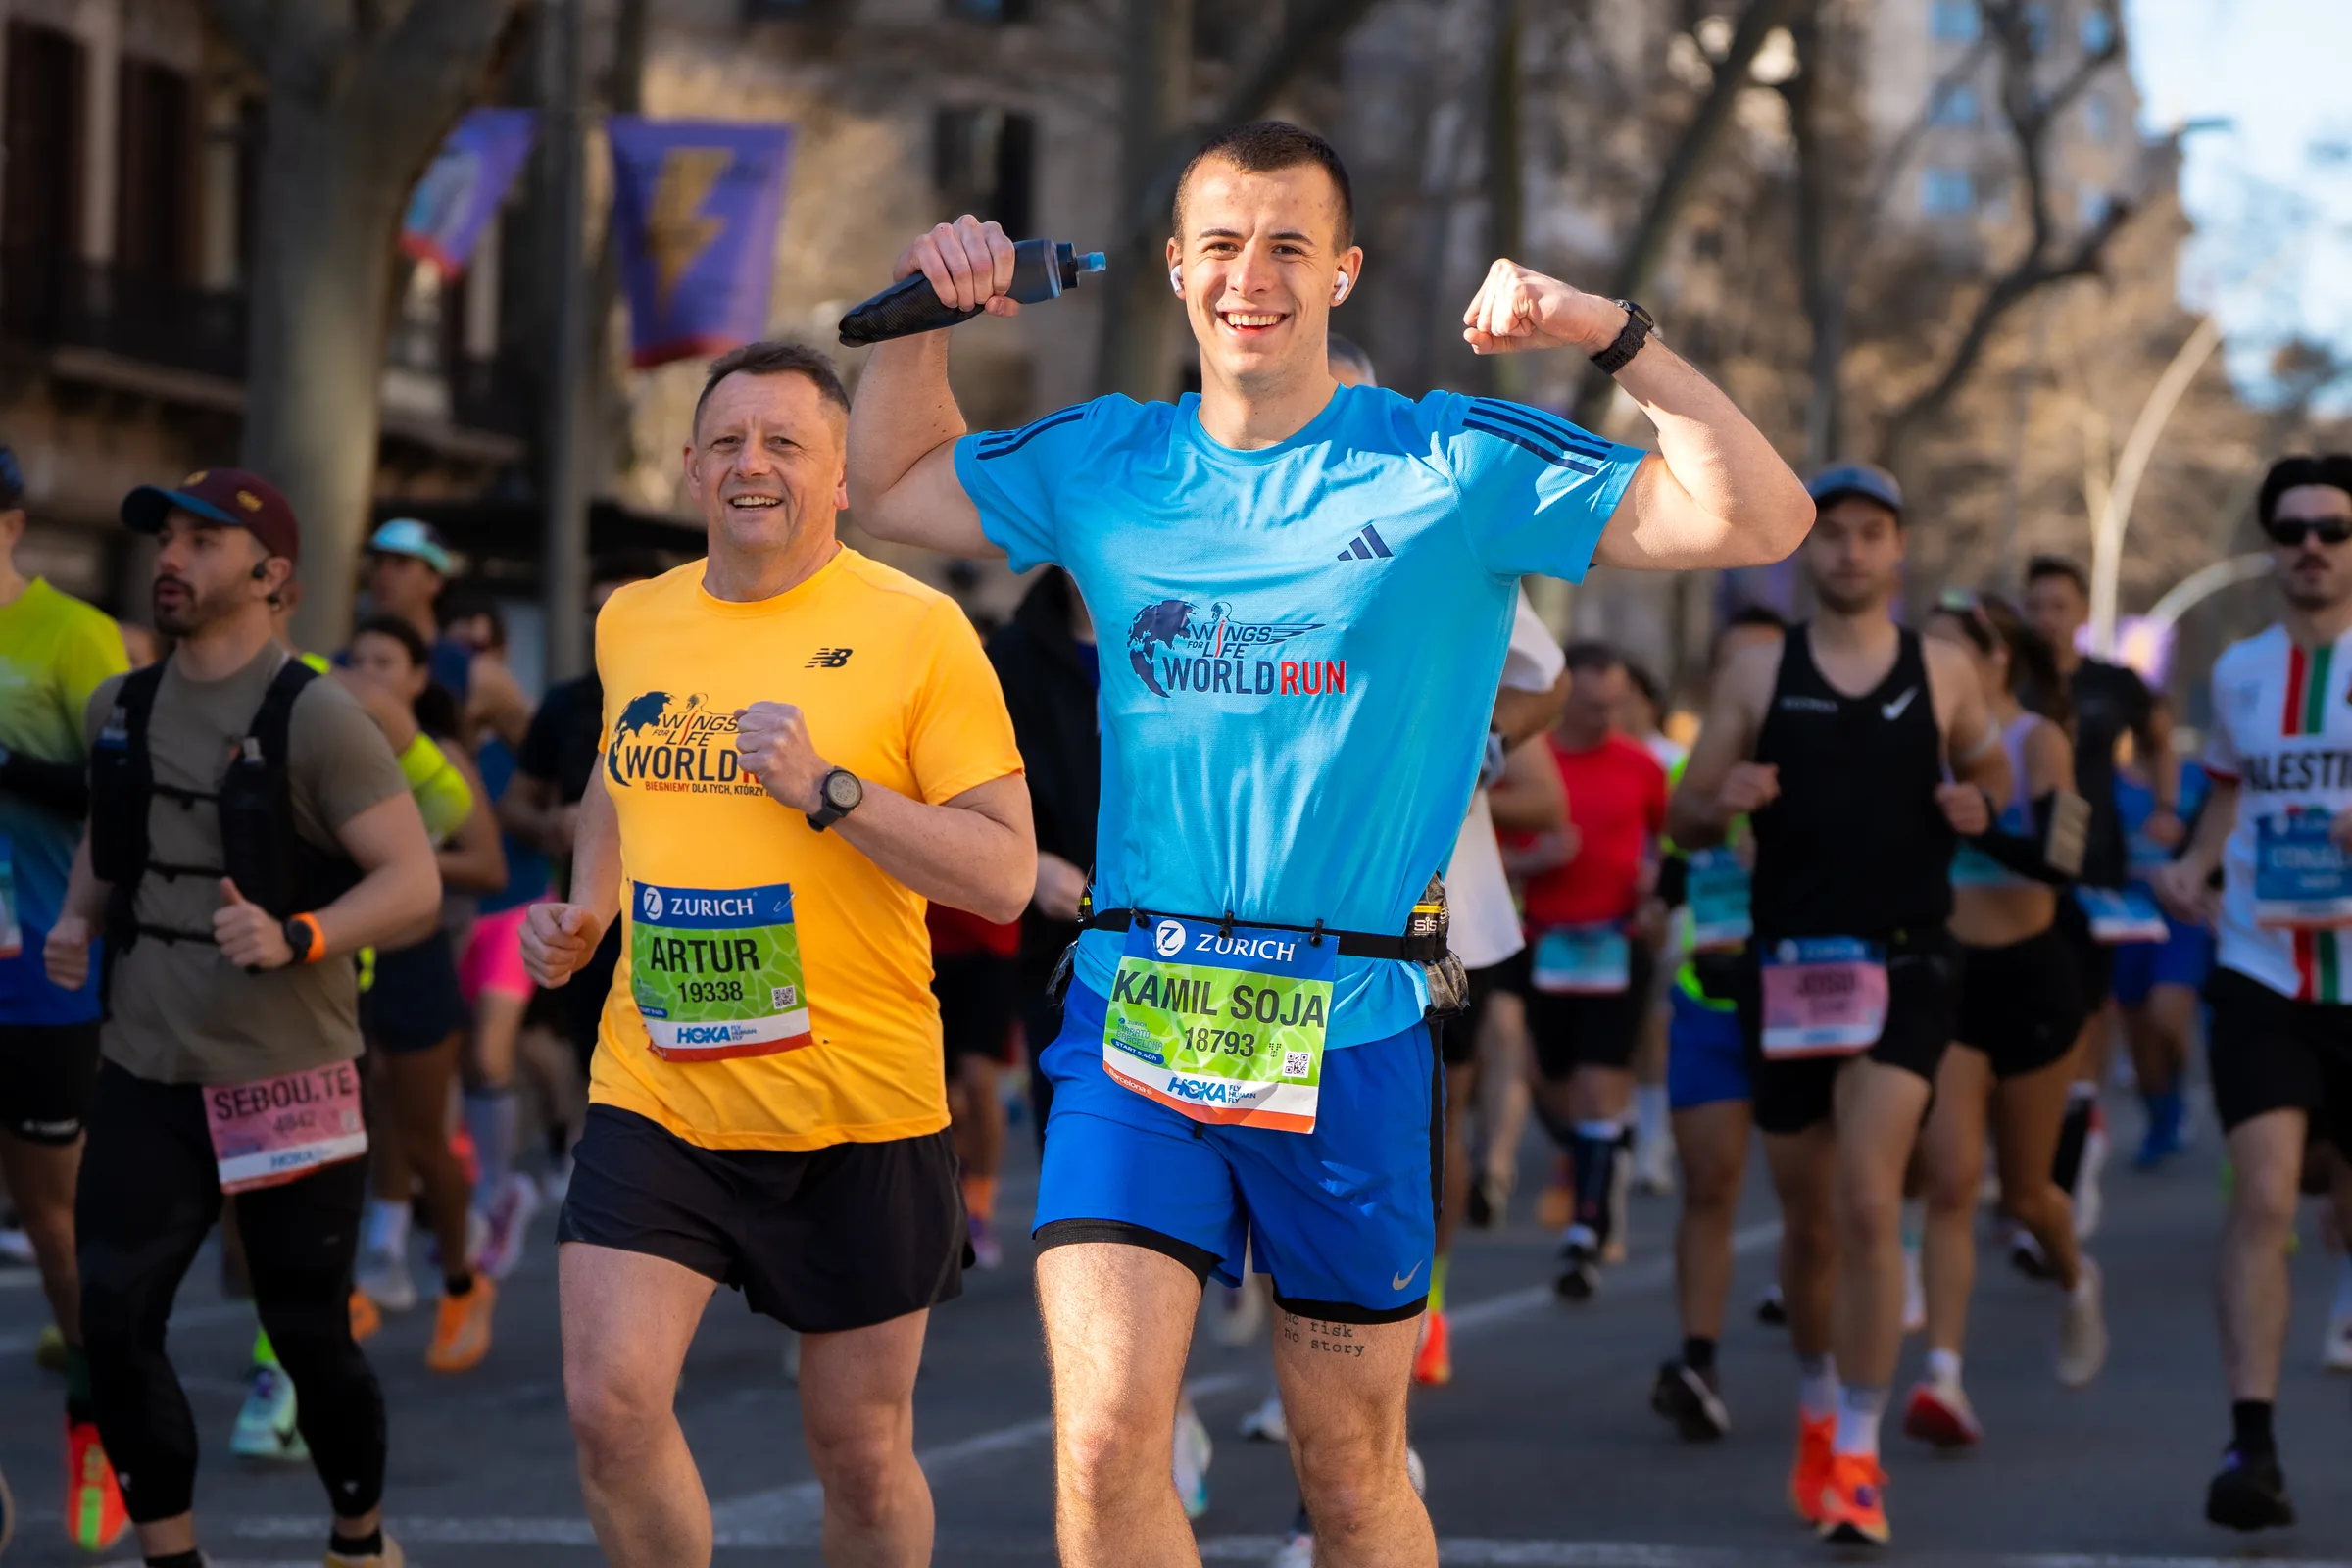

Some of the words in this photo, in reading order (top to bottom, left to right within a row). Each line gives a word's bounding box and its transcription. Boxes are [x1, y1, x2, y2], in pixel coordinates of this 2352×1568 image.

[1191, 619, 1273, 642] WINGS
[1187, 640, 1203, 649] FOR
[1202, 641, 1250, 659] LIFE
[1162, 657, 1275, 695] WORLD
[1280, 660, 1347, 695] RUN
[652, 728, 670, 737] FOR
[662, 711, 738, 732] WINGS
[665, 730, 715, 747] LIFE
[625, 745, 738, 782] WORLD
[645, 781, 690, 793] BIEGNIEMY
[692, 783, 708, 793] DLA
[710, 784, 732, 796] TYCH,
[734, 783, 764, 797] KTÓRZY
[670, 897, 754, 917] ZURICH
[650, 936, 760, 974] ARTUR
[1195, 933, 1297, 962] ZURICH
[677, 981, 744, 1004] 19338
[1111, 969, 1218, 1016] KAMIL
[1230, 984, 1325, 1028] SOJA
[676, 1026, 731, 1044] HOKA
[1116, 1030, 1163, 1052] BARCELONA
[1184, 1027, 1255, 1058] 18793
[1115, 1041, 1137, 1054] START
[1108, 1067, 1146, 1094] Barcelona
[1166, 1076, 1227, 1102] HOKA
[214, 1066, 352, 1121] SEBOU.TE
[1284, 1311, 1299, 1326] no
[1309, 1320, 1353, 1338] risk
[1284, 1327, 1299, 1343] no
[1310, 1339, 1365, 1358] story
